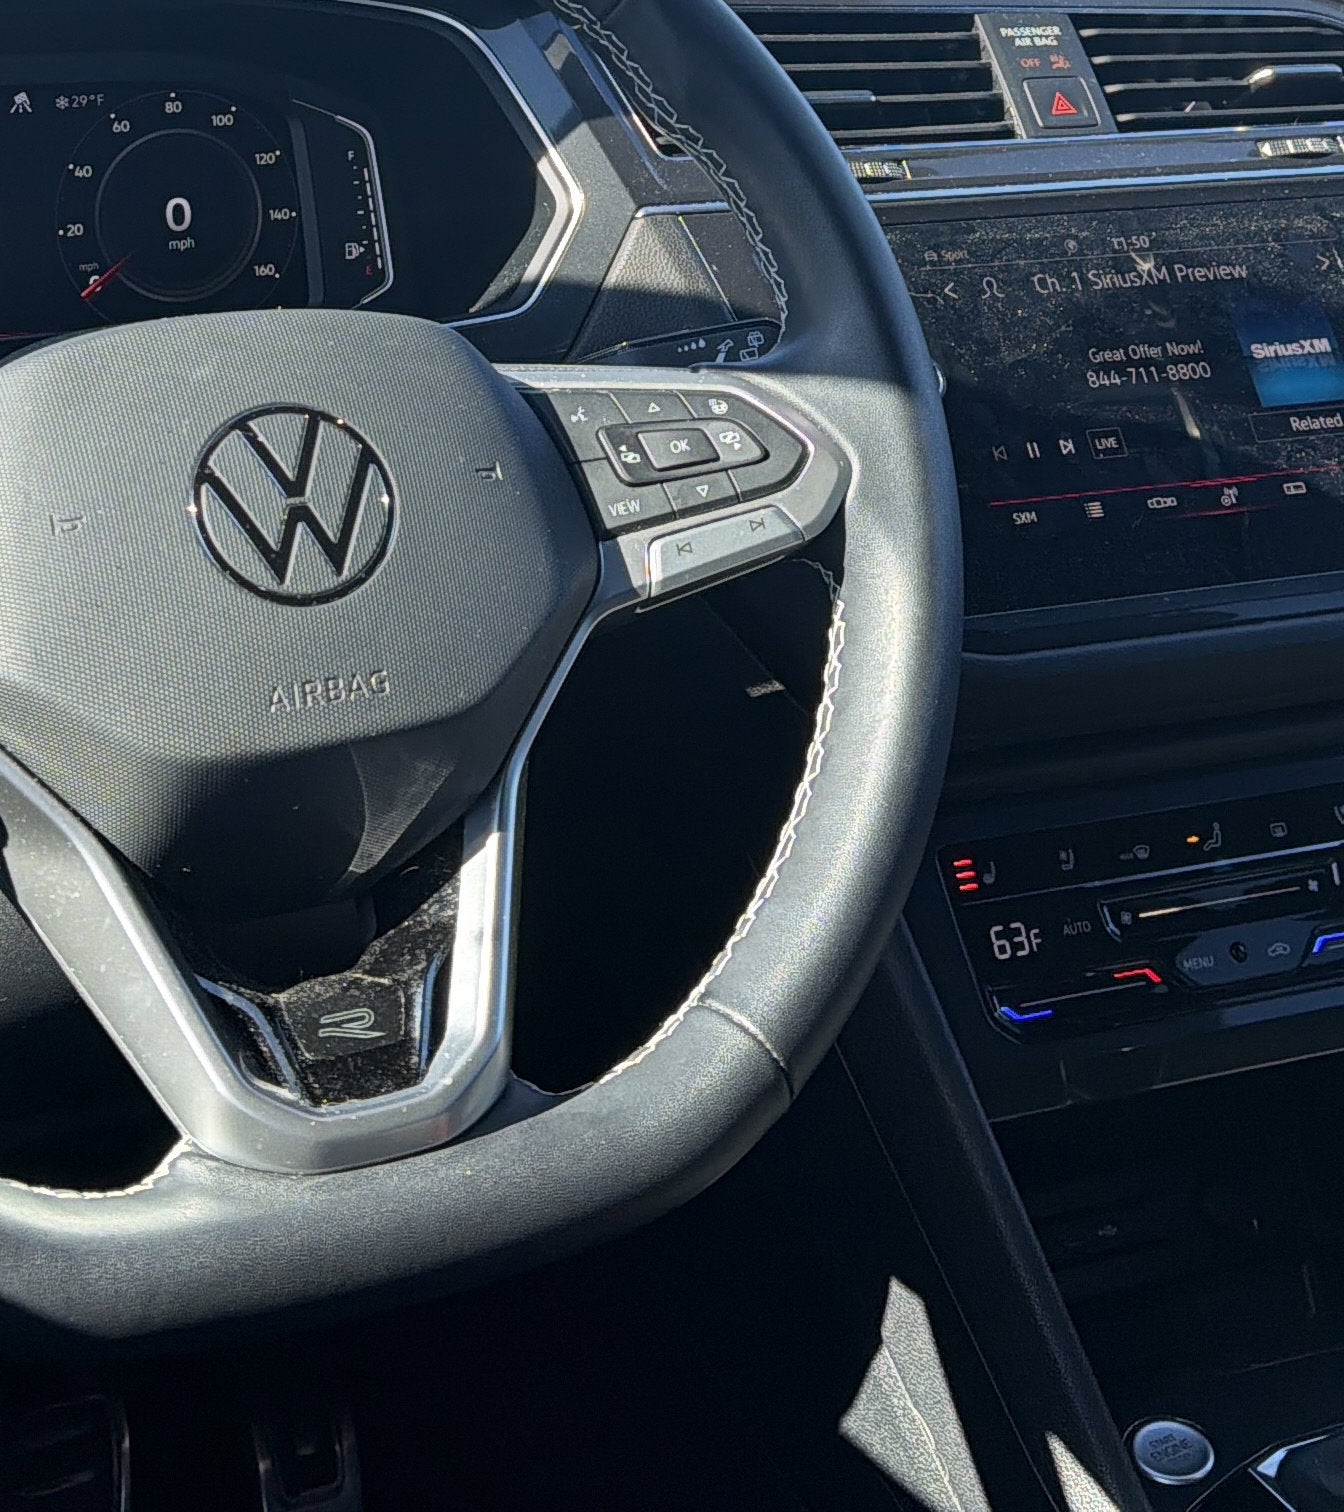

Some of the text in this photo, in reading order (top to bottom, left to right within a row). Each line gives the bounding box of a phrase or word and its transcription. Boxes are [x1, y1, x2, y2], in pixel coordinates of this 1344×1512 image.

[1000, 26, 1062, 37] PASSENGER
[1014, 36, 1058, 47] AIR BAG
[1020, 58, 1041, 68] OFF
[165, 100, 182, 114] 80
[112, 119, 131, 133] 60
[211, 114, 234, 127] 100
[255, 152, 276, 165] 120
[348, 149, 355, 161] F
[74, 165, 93, 178] 40
[165, 197, 192, 232] 0
[268, 208, 290, 221] 140
[66, 224, 84, 237] 20
[168, 236, 196, 252] mph
[254, 264, 275, 277] 160
[366, 265, 373, 275] E
[1032, 264, 1248, 294] Ch. 1 SiriusXM Preview
[1088, 339, 1204, 363] Great Offer Now!
[1250, 338, 1332, 359] SiriusXM
[1086, 361, 1212, 388] 844-711-8800
[1289, 413, 1344, 432] Related
[670, 439, 691, 454] OK
[1095, 437, 1119, 450] LIVE
[608, 498, 641, 517] VIEW
[1012, 511, 1038, 525] SXM
[270, 670, 391, 714] AIRBAG
[1063, 920, 1092, 936] AUTO
[1182, 955, 1214, 971] MENU
